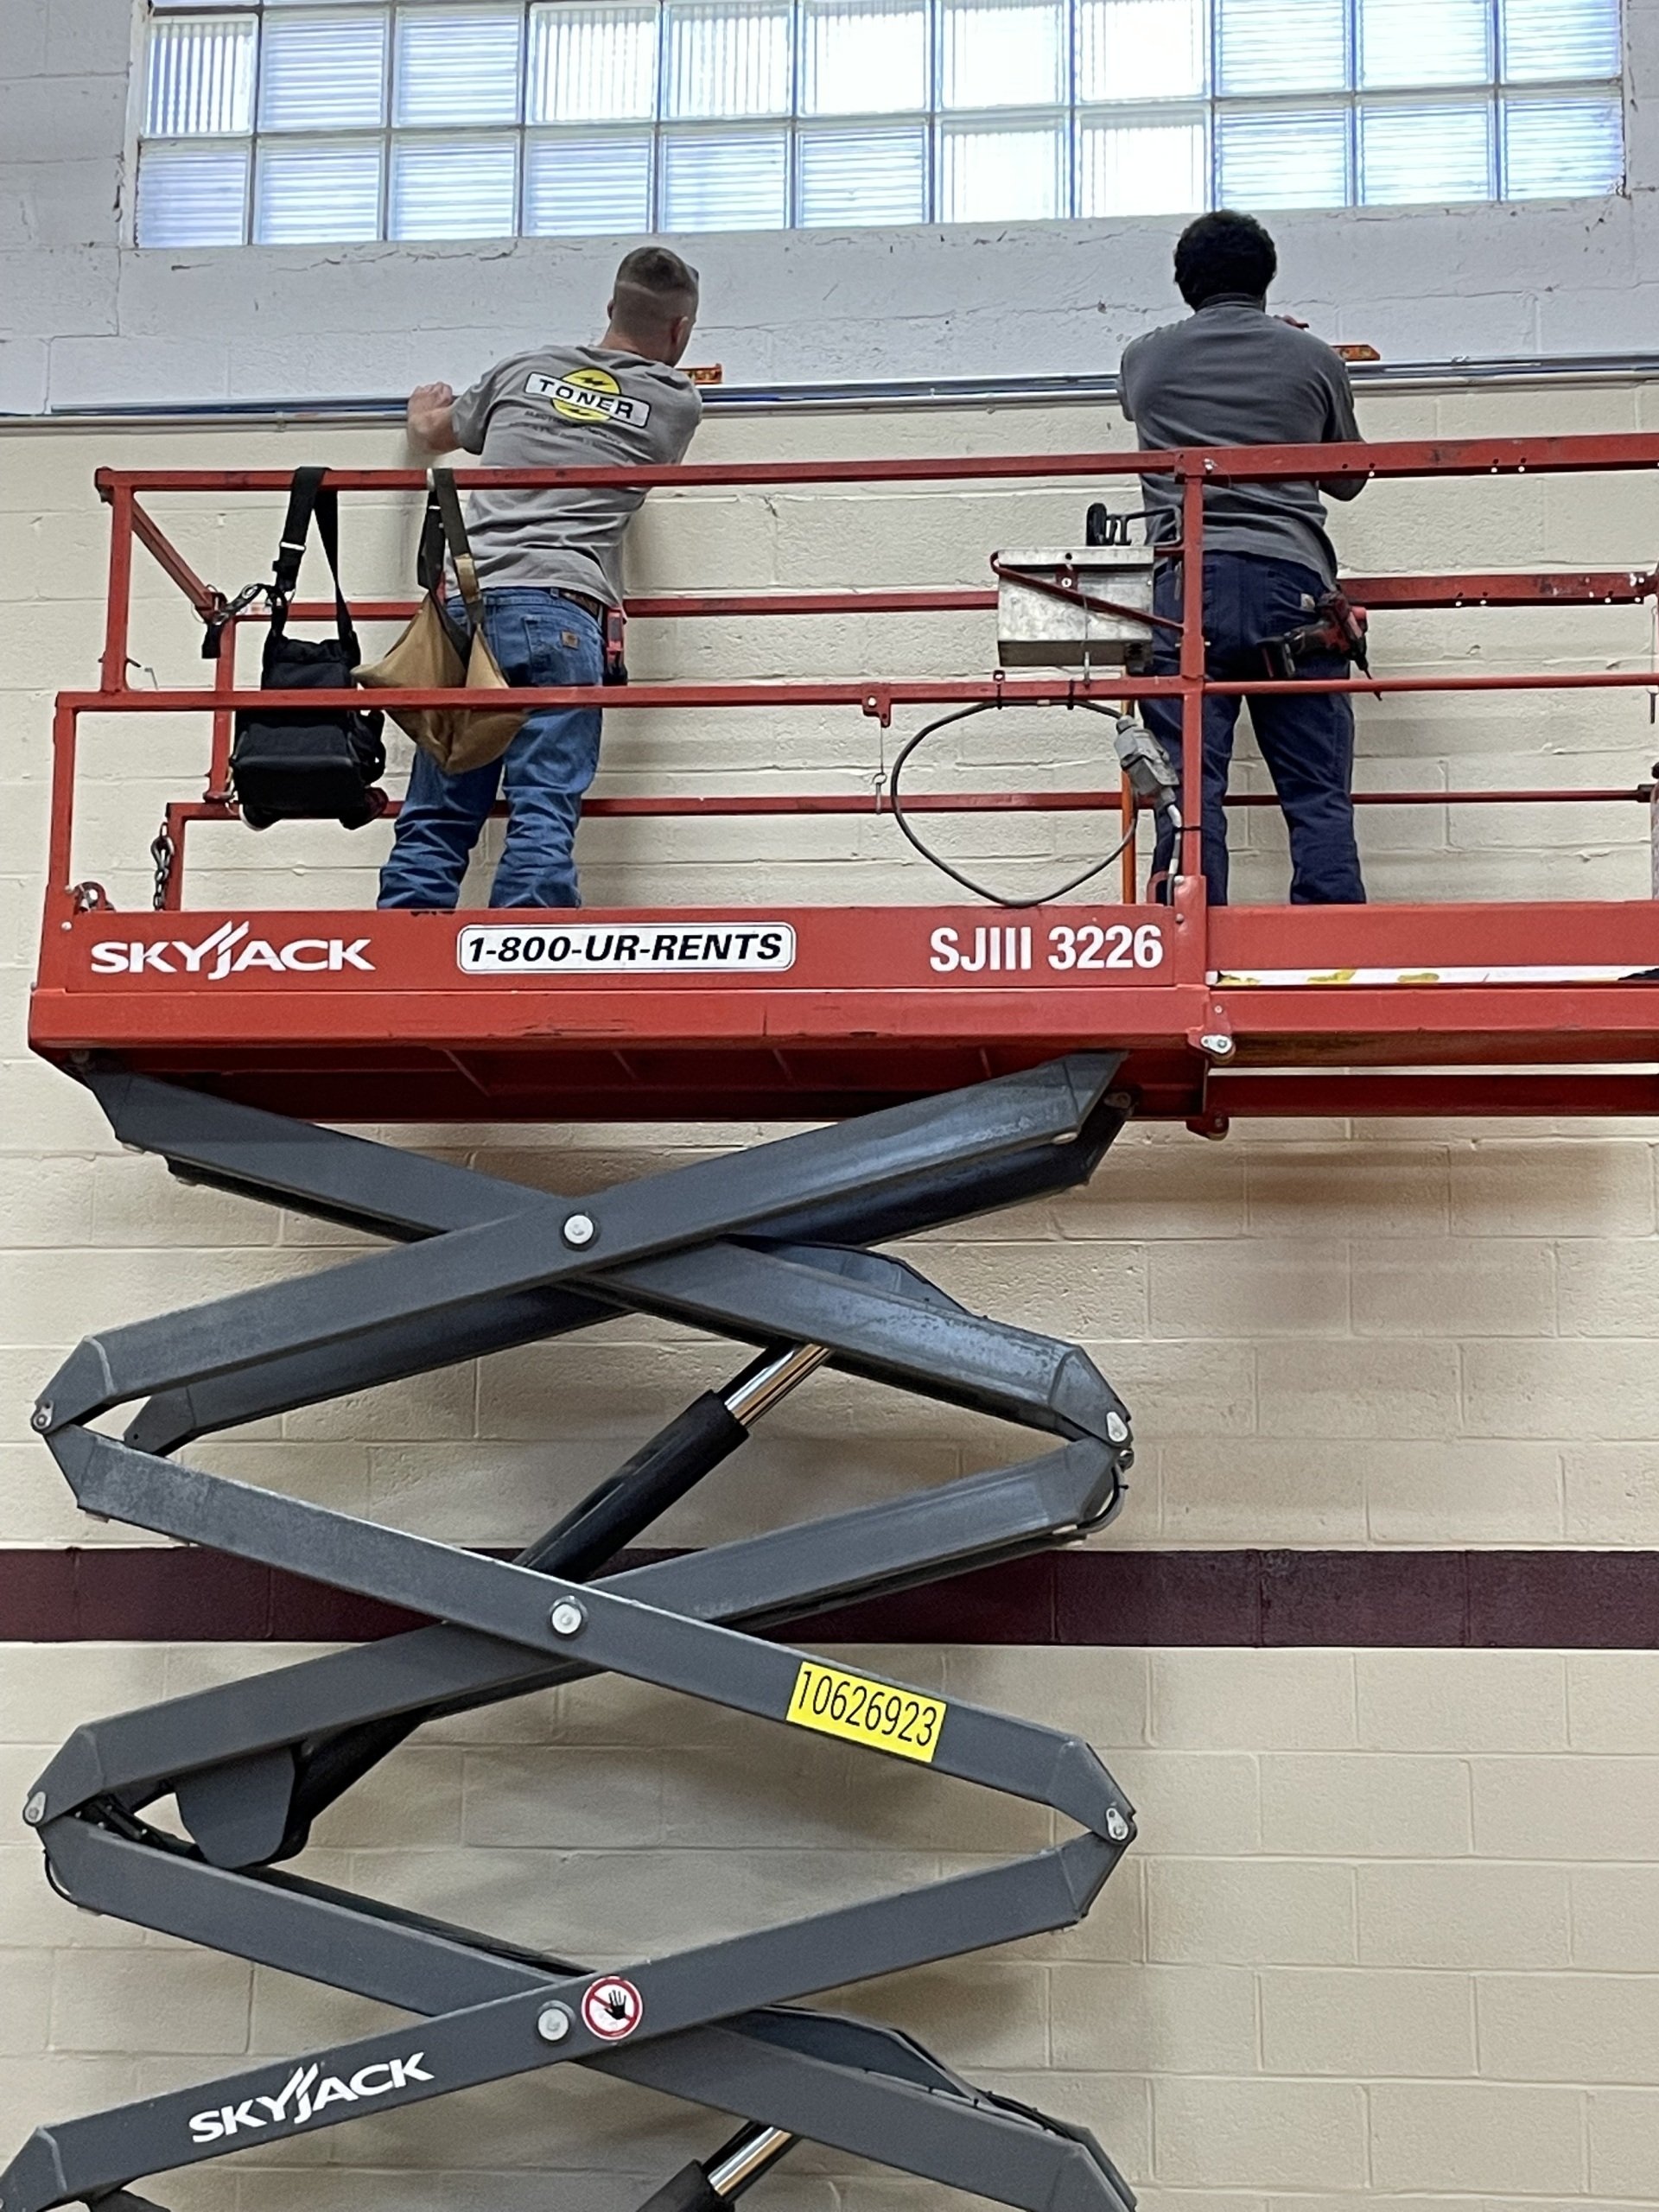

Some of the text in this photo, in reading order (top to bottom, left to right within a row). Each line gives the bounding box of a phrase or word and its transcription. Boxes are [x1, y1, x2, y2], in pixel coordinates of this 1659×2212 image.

[539, 378, 633, 419] TONER
[91, 920, 376, 981] SKYJACK
[468, 932, 782, 963] 1-800-UR-RENTS
[930, 925, 1164, 972] SJIII 3226
[798, 1670, 938, 1746] 10626923
[188, 2051, 435, 2143] SKYJACK
